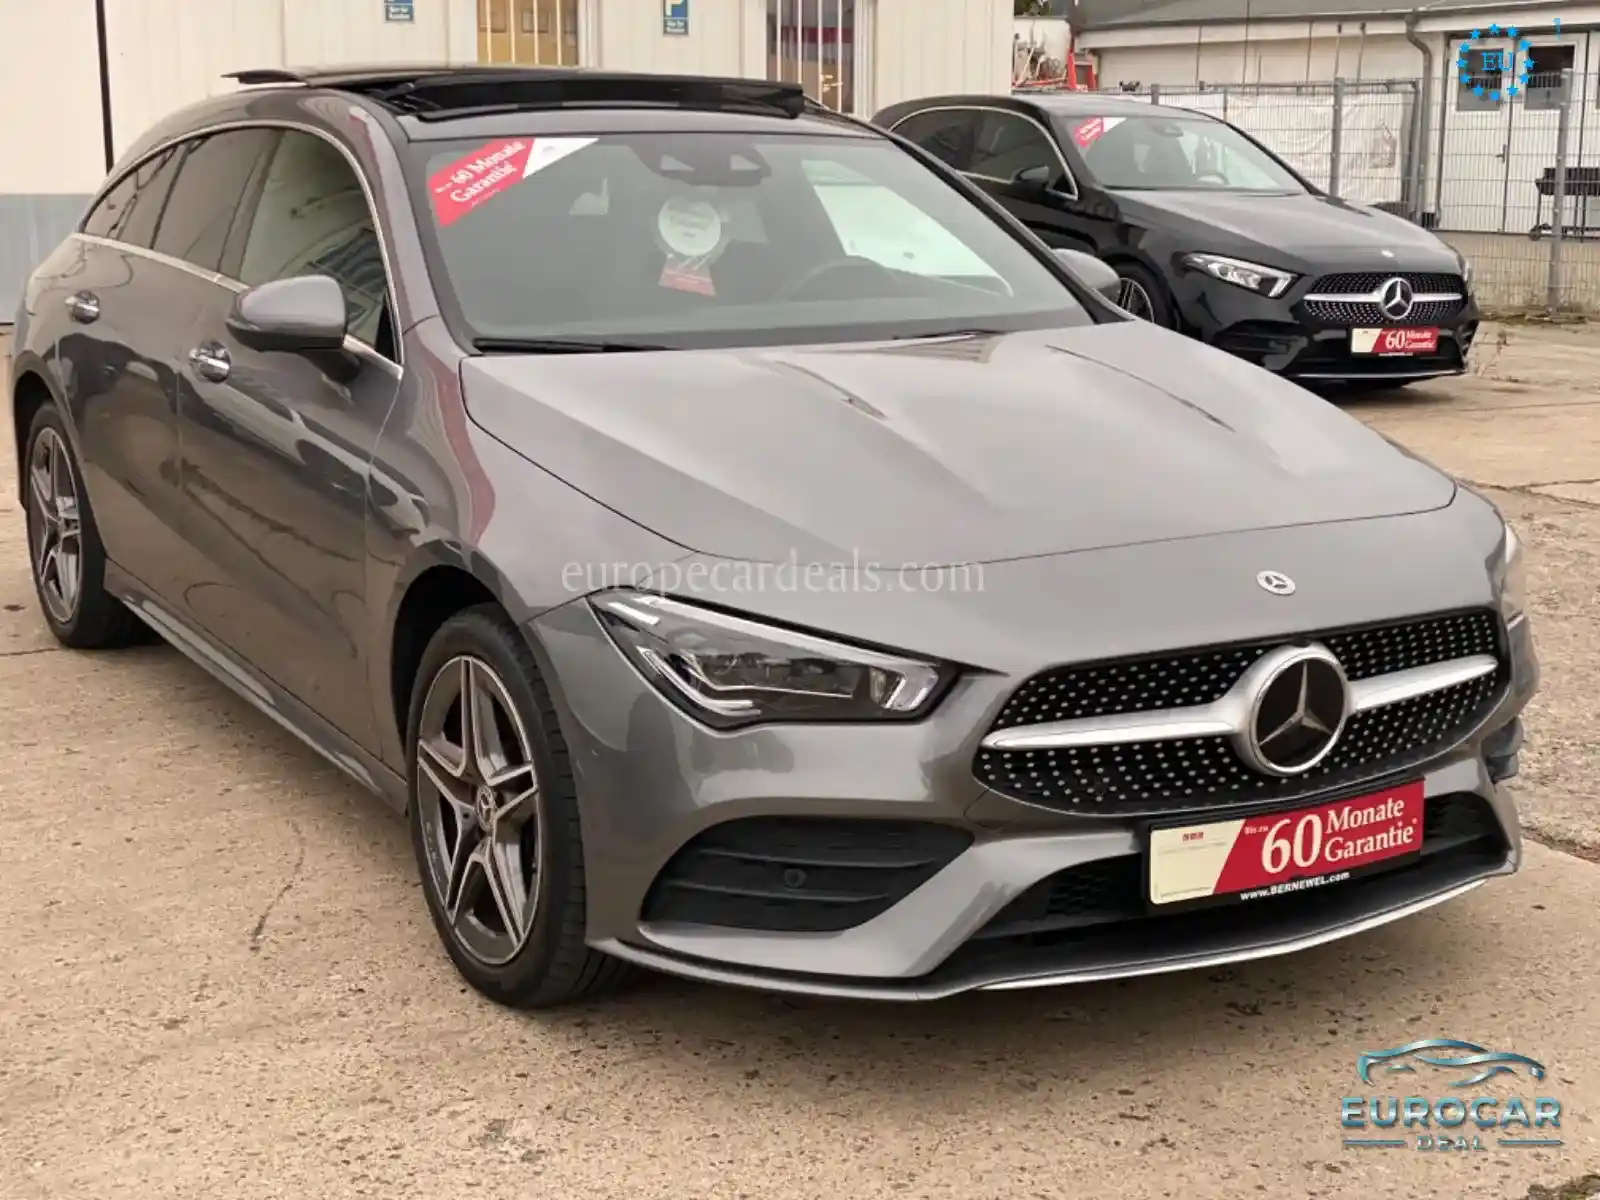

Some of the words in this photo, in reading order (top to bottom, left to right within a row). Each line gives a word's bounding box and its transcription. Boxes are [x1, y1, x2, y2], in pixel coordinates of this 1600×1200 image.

[1385, 330, 1406, 349] 60
[1261, 814, 1322, 874] 60
[1324, 797, 1405, 834] Monate
[1240, 871, 1350, 900] www.BERNEWEL.com
